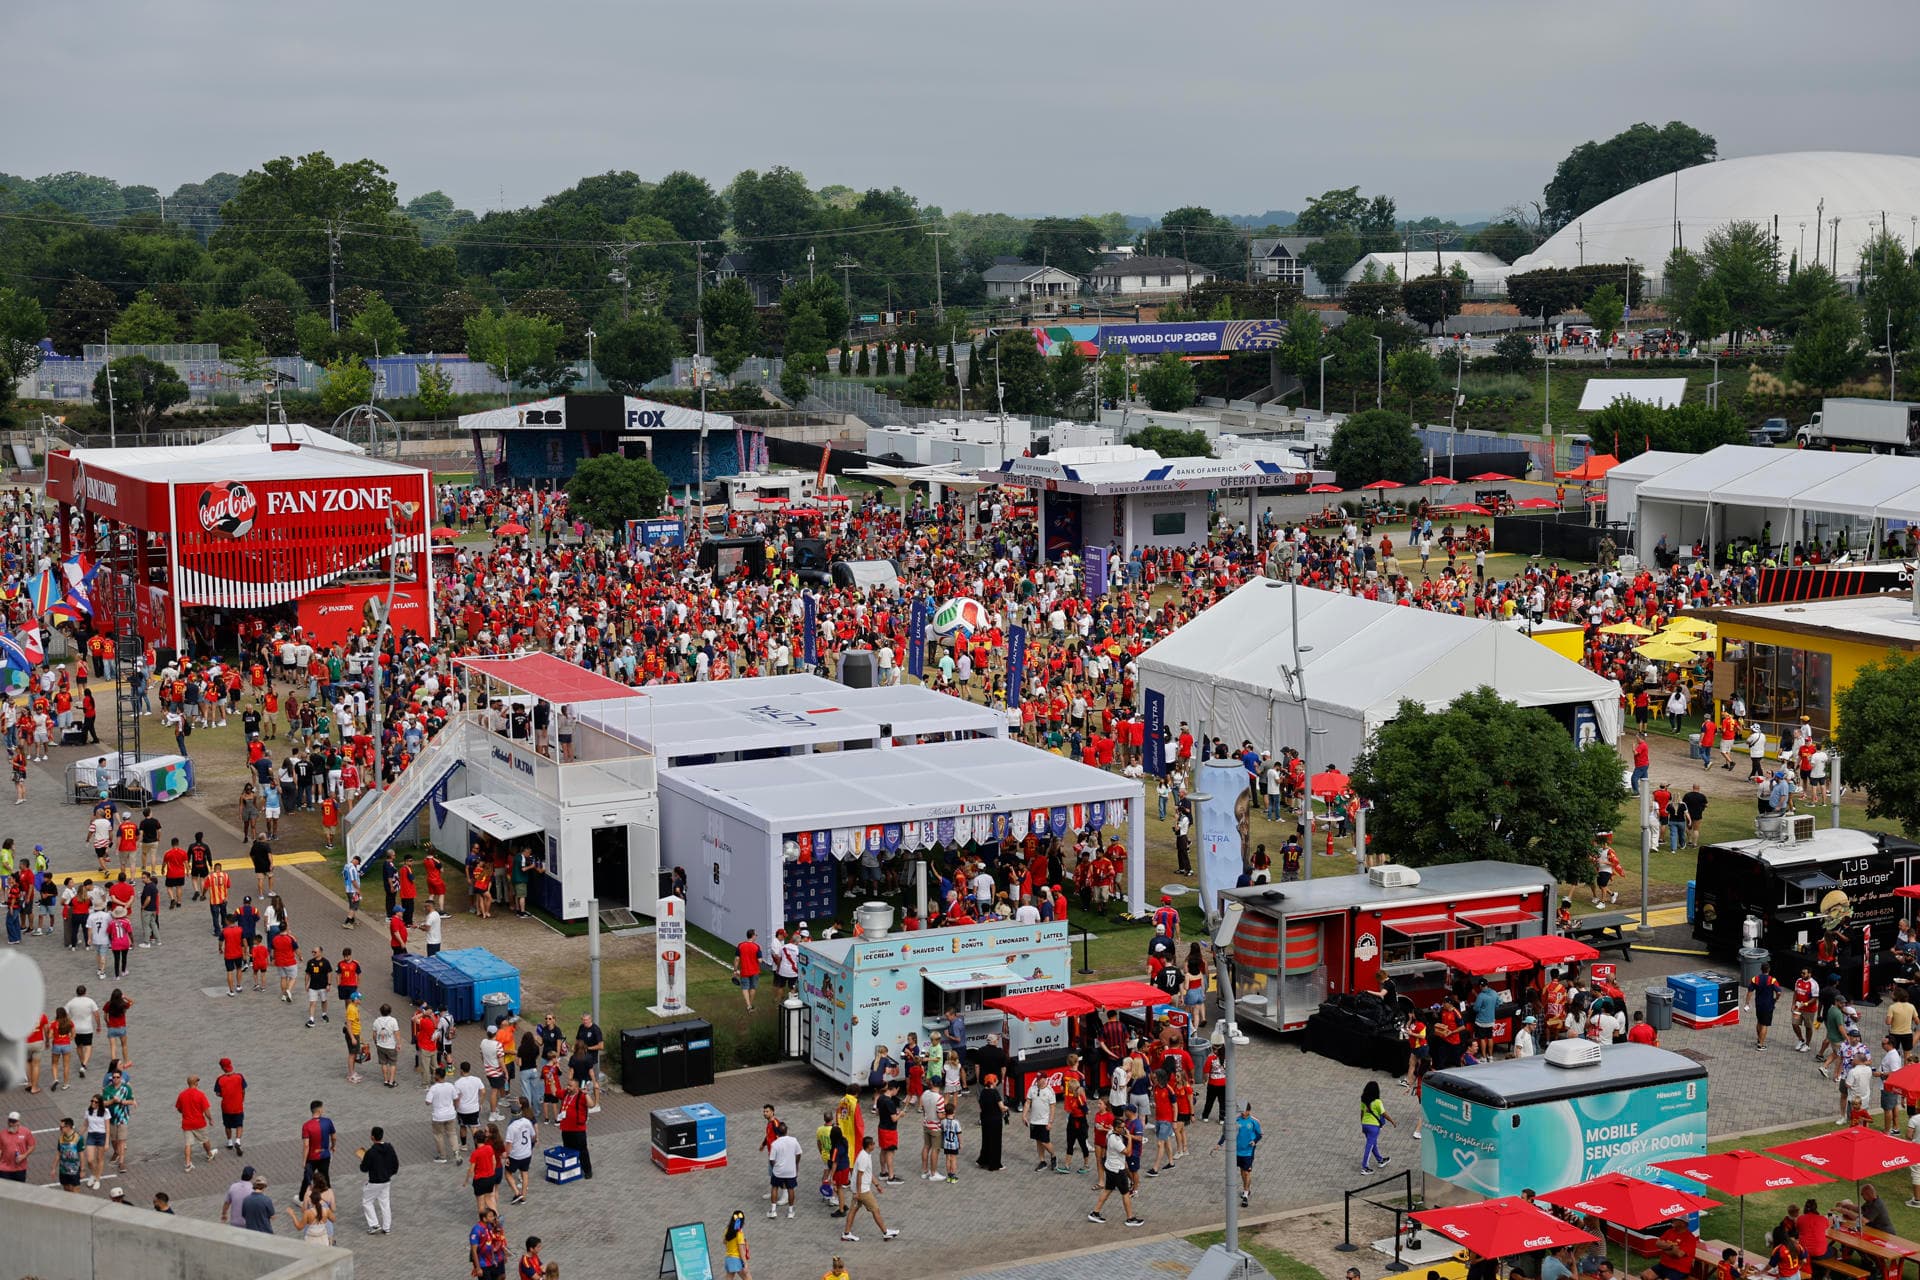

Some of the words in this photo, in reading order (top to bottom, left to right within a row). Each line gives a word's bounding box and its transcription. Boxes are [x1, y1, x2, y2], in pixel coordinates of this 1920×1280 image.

[1129, 334, 1162, 344] WORLD
[1164, 333, 1183, 343] CUP
[1184, 332, 1217, 342] 2026
[525, 410, 562, 425] 26
[627, 410, 666, 428] FOX
[1207, 465, 1237, 474] AMERICA
[1003, 474, 1024, 485] OFERTA
[1025, 477, 1034, 486] DE
[1220, 475, 1257, 487] OFERTA
[1259, 475, 1271, 485] DE
[1273, 474, 1288, 484] 6%
[1141, 484, 1173, 492] AMERICA
[267, 490, 316, 515] FAN
[322, 487, 392, 512] ZONE
[199, 485, 257, 531] Coca-Cola
[647, 524, 661, 532] WE
[328, 604, 354, 612] FANZONE
[393, 602, 419, 610] ATLANTA
[1012, 634, 1020, 664] ULTRA
[514, 757, 534, 777] ULTRA
[967, 803, 997, 813] ULTRA
[123, 828, 134, 841] 19
[924, 832, 935, 843] 26
[1203, 833, 1230, 843] ULTRA
[1842, 858, 1869, 873] TJB
[1859, 873, 1890, 885] Burger
[96, 921, 102, 933] 7
[115, 926, 124, 938] 11
[996, 936, 1029, 945] LEMONADES
[1043, 932, 1063, 940] LATTES
[873, 952, 894, 960] CREAM
[912, 947, 936, 955] SHAVED
[1008, 987, 1034, 995] PRIVATE
[1034, 984, 1065, 992] CATERING
[1656, 1091, 1682, 1099] Hisense
[1435, 1097, 1458, 1111] Hisense
[520, 1129, 528, 1145] 5
[1586, 1122, 1638, 1143] MOBILE
[1585, 1140, 1649, 1160] SENSORY
[1651, 1131, 1694, 1151] ROOM
[1882, 1155, 1909, 1168] Coca-Cola
[1765, 1177, 1795, 1187] Coca-Cola
[1660, 1204, 1685, 1216] Coca-Cola
[1523, 1236, 1553, 1248] Coca-Cola
